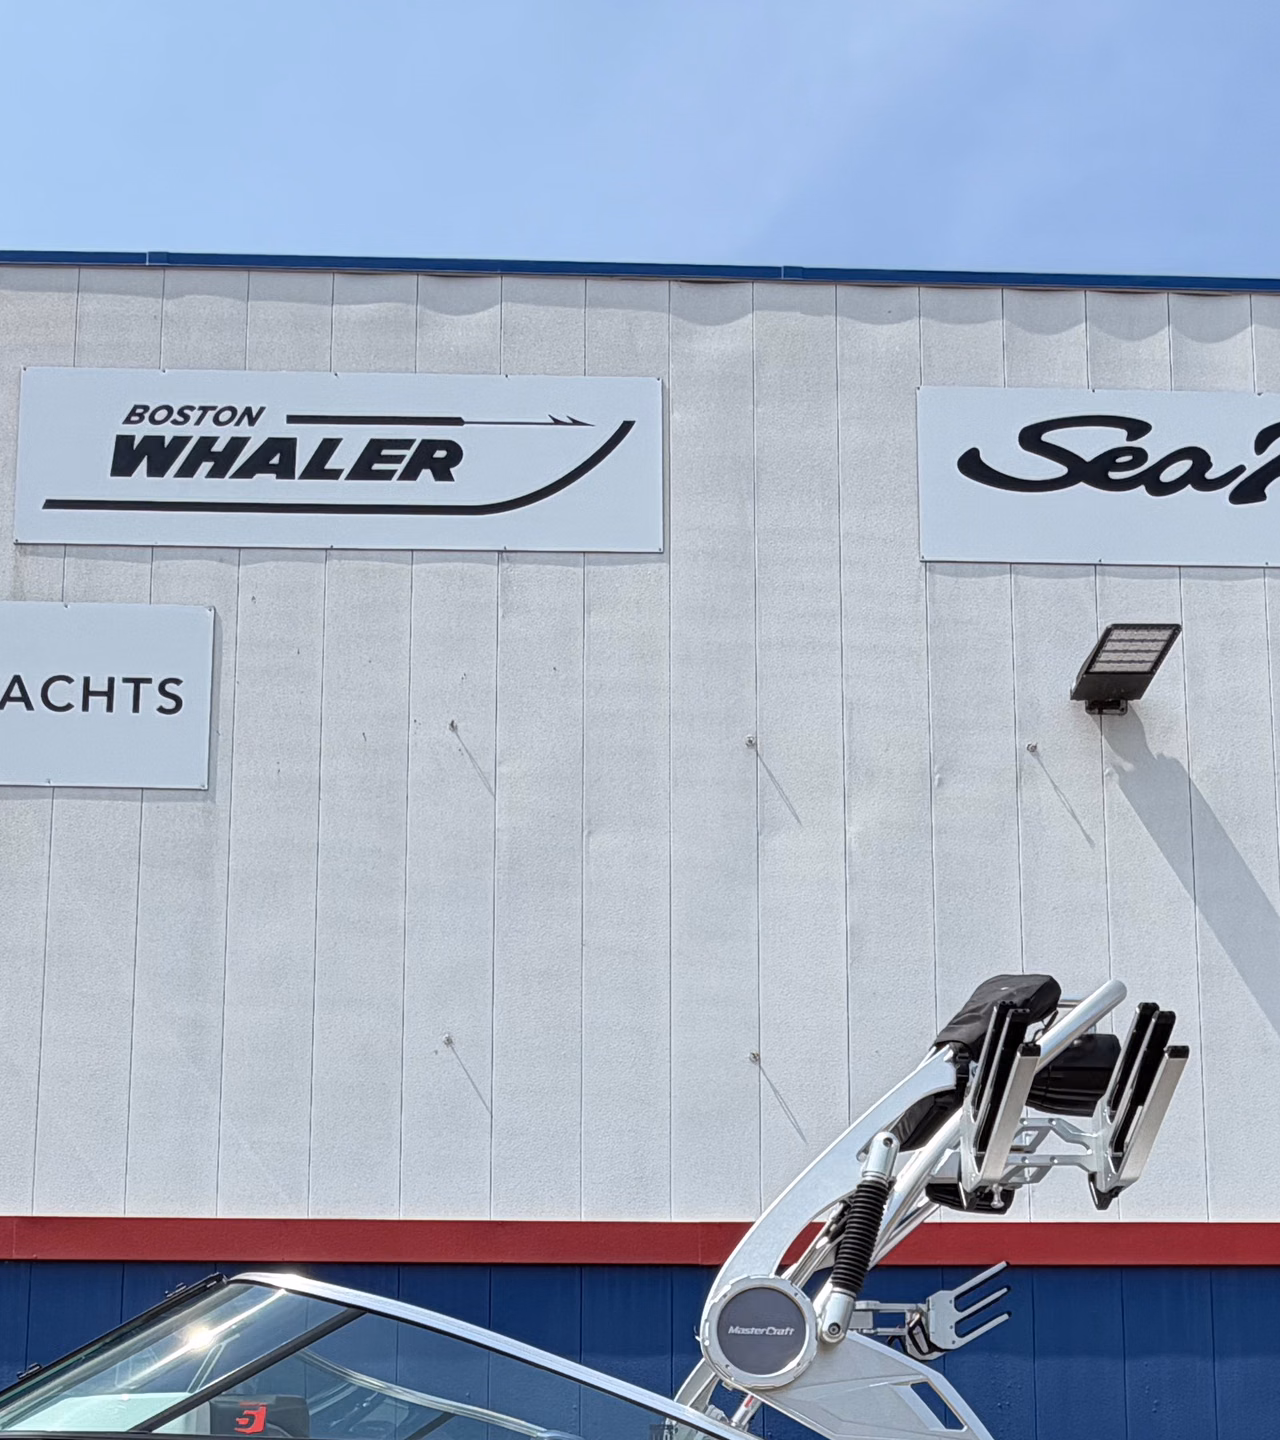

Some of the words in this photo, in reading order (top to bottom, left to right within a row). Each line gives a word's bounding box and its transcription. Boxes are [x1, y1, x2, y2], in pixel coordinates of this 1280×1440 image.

[121, 404, 267, 427] BOSTON
[109, 434, 464, 482] WHALER
[956, 414, 1247, 497] Sea
[727, 1325, 796, 1336] MasterCraft
